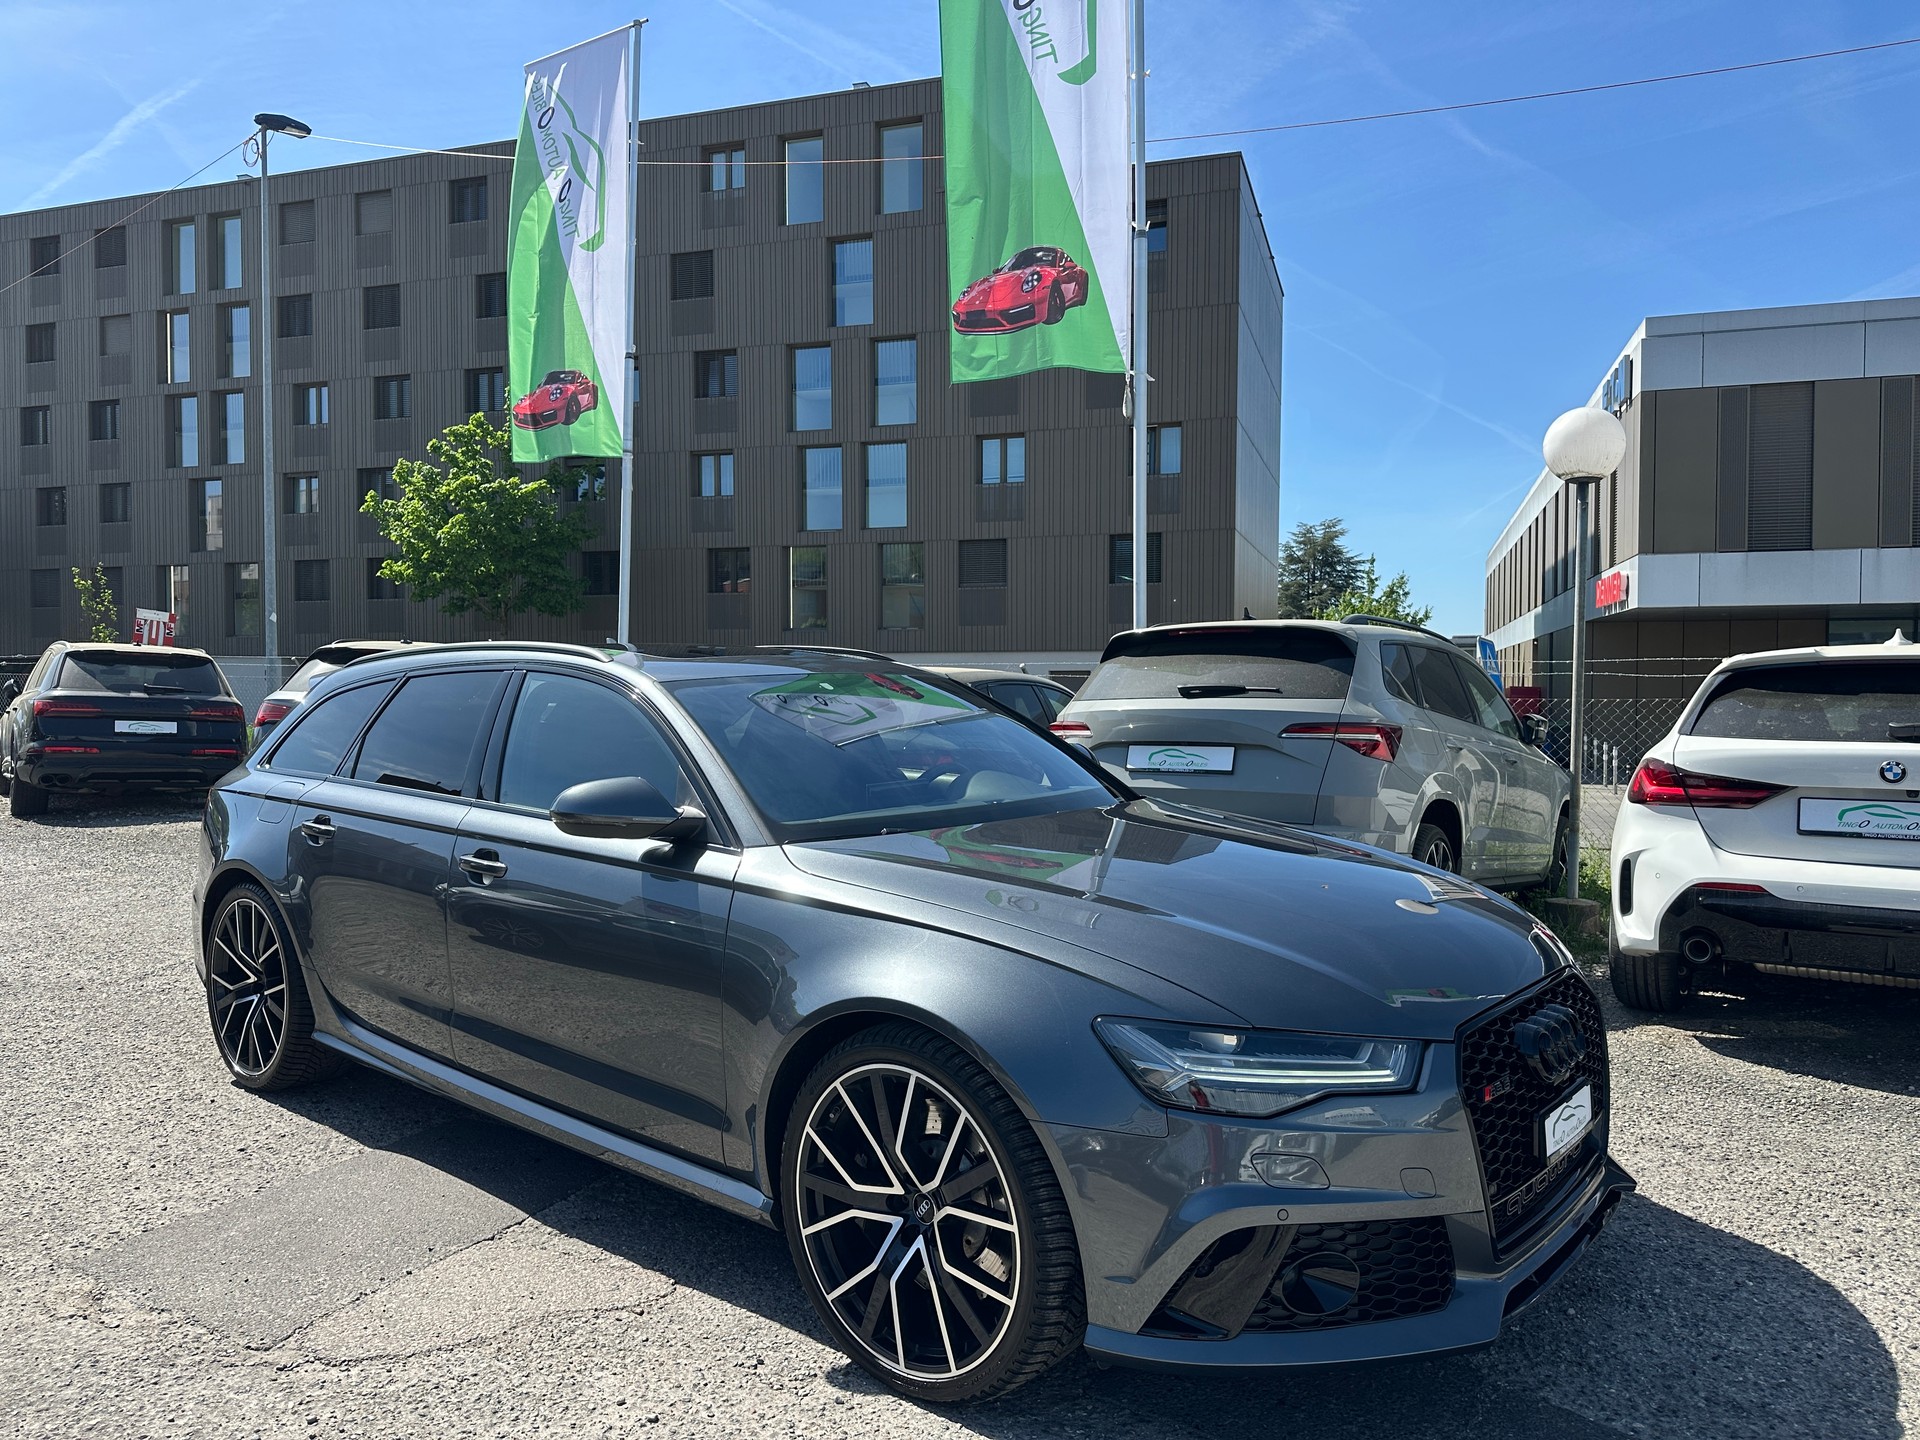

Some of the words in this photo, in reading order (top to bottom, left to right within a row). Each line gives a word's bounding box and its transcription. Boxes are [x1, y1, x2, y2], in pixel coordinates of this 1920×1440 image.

[136, 620, 144, 633] MF
[166, 623, 174, 636] MF
[1837, 820, 1870, 829] TINGO
